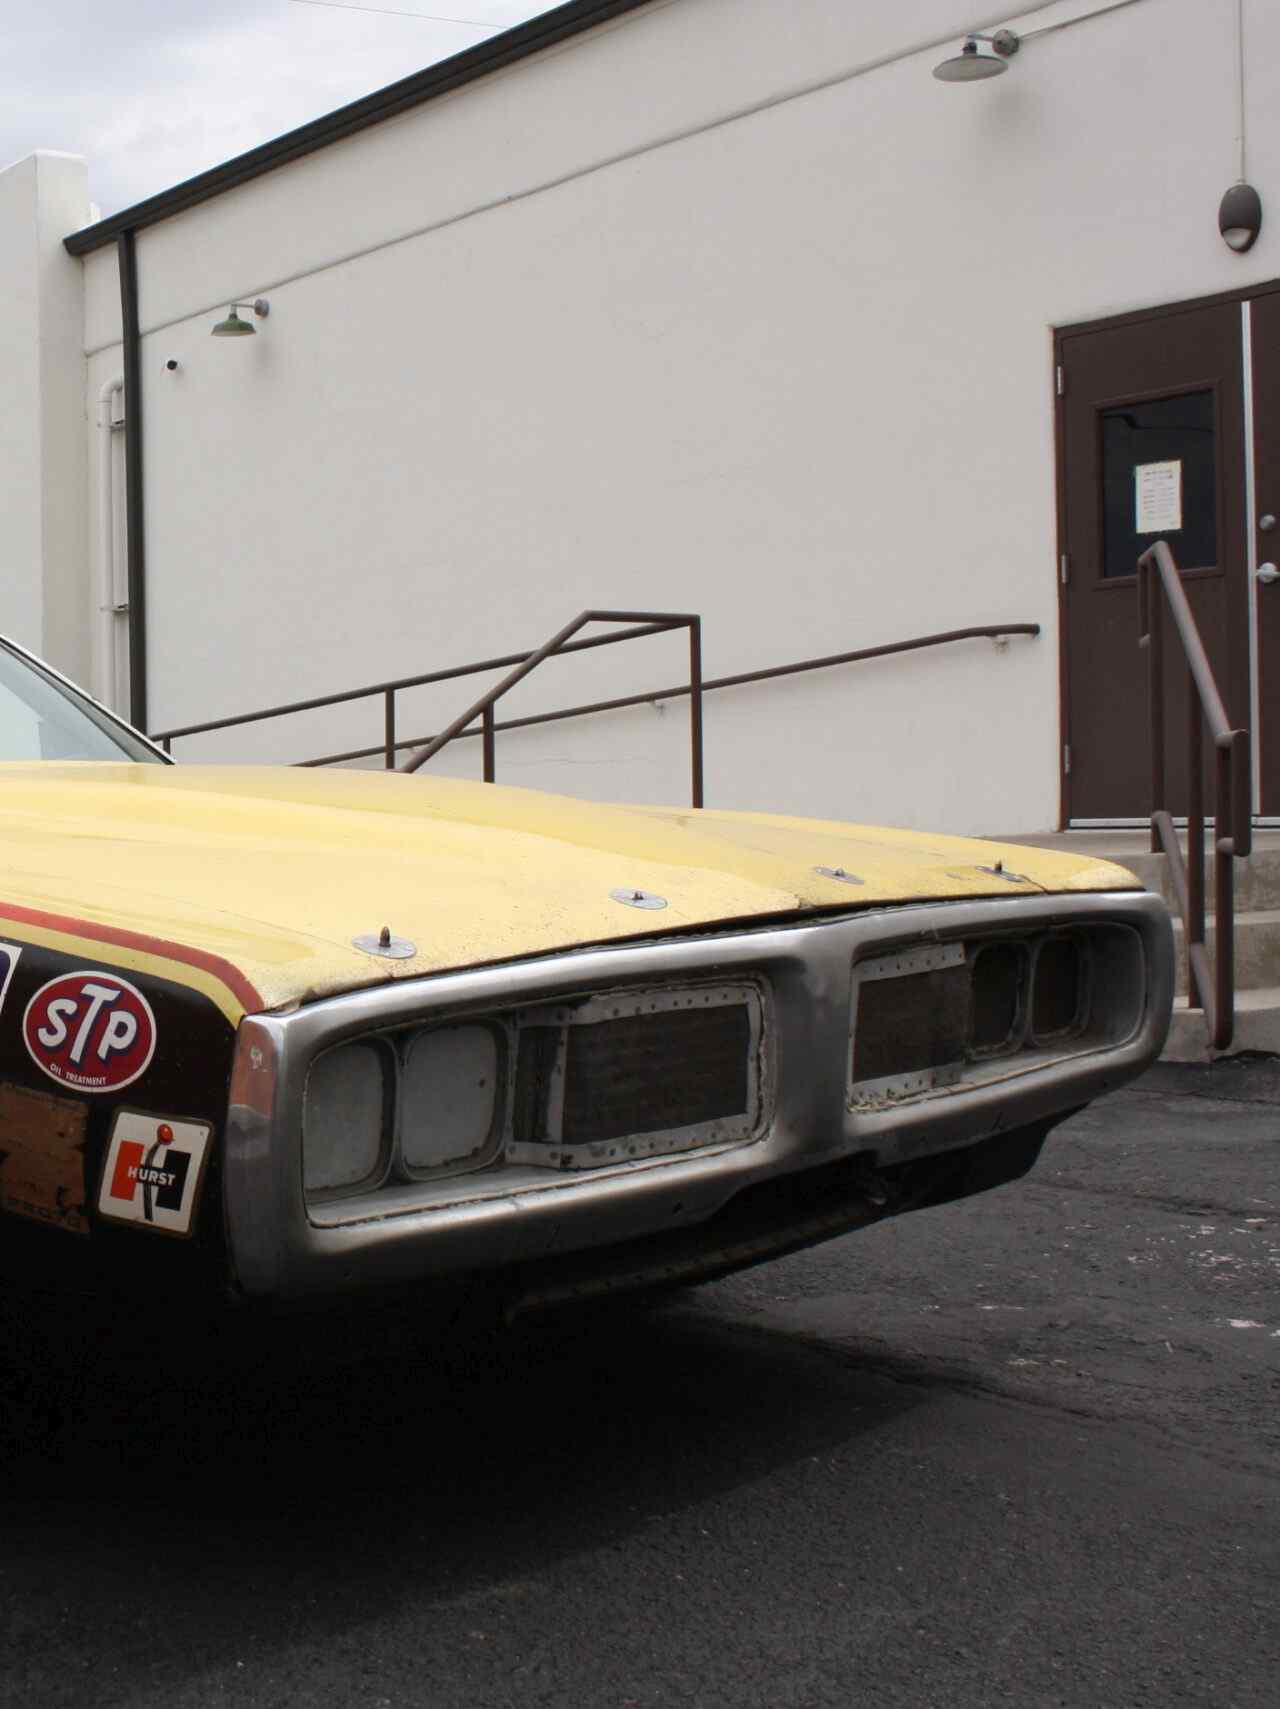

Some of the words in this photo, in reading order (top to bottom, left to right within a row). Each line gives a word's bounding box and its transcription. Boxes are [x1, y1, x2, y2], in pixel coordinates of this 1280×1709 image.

[37, 983, 138, 1064] STP
[49, 1063, 62, 1076] OIL
[65, 1071, 107, 1086] TREATMENT
[127, 1166, 176, 1187] HURST
